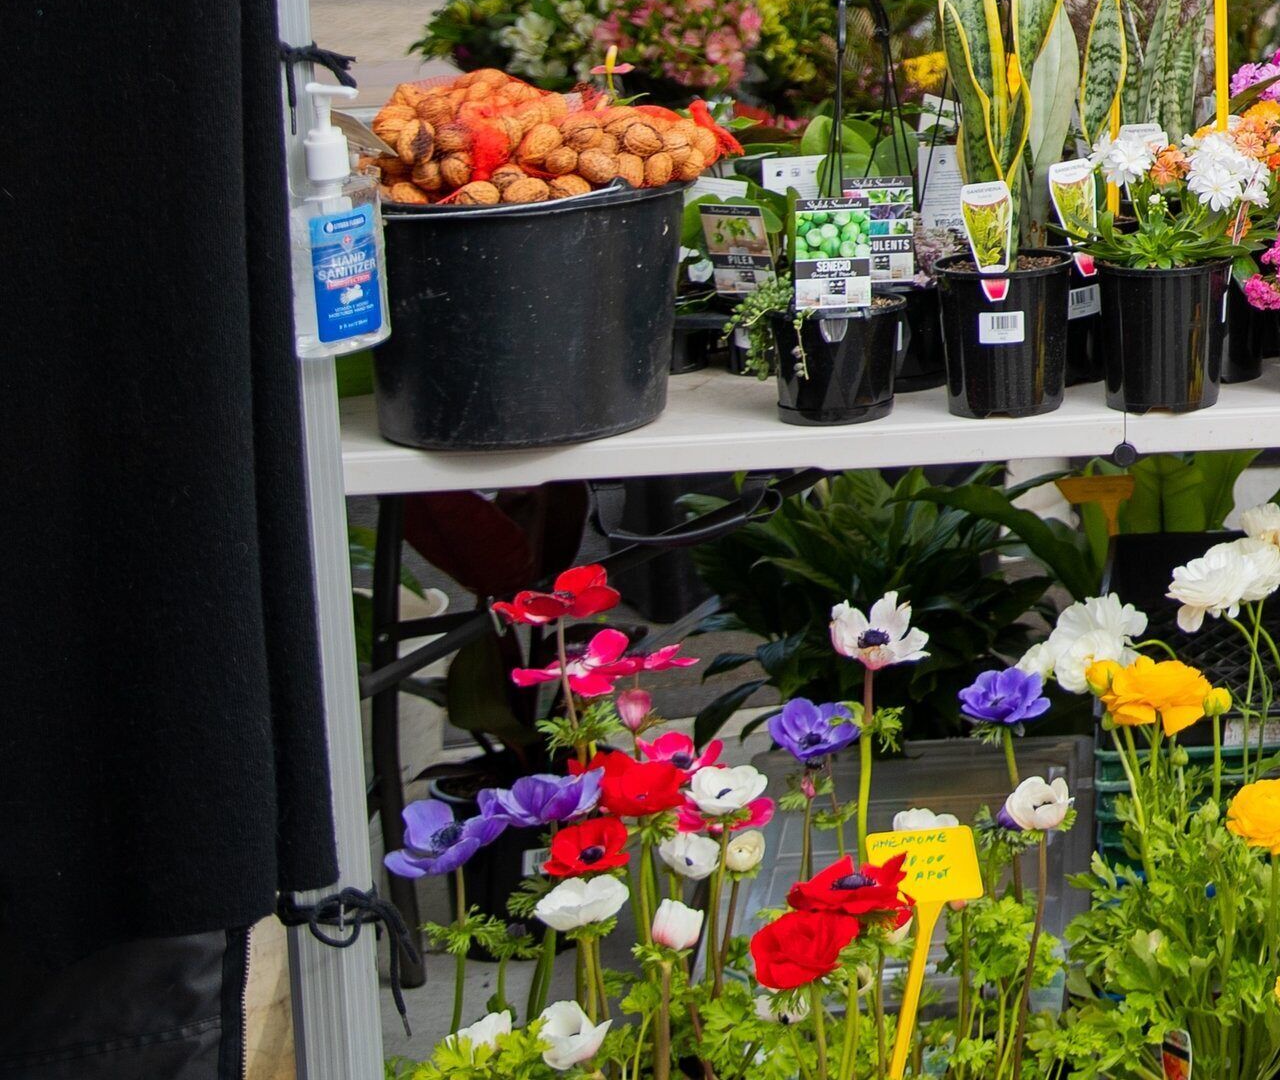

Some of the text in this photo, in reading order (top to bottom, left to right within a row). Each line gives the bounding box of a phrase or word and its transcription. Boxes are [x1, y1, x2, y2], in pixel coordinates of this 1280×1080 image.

[331, 251, 366, 268] HAND
[727, 255, 754, 265] PILEA
[816, 260, 851, 272] SENECIO
[318, 258, 377, 281] SANITIZER
